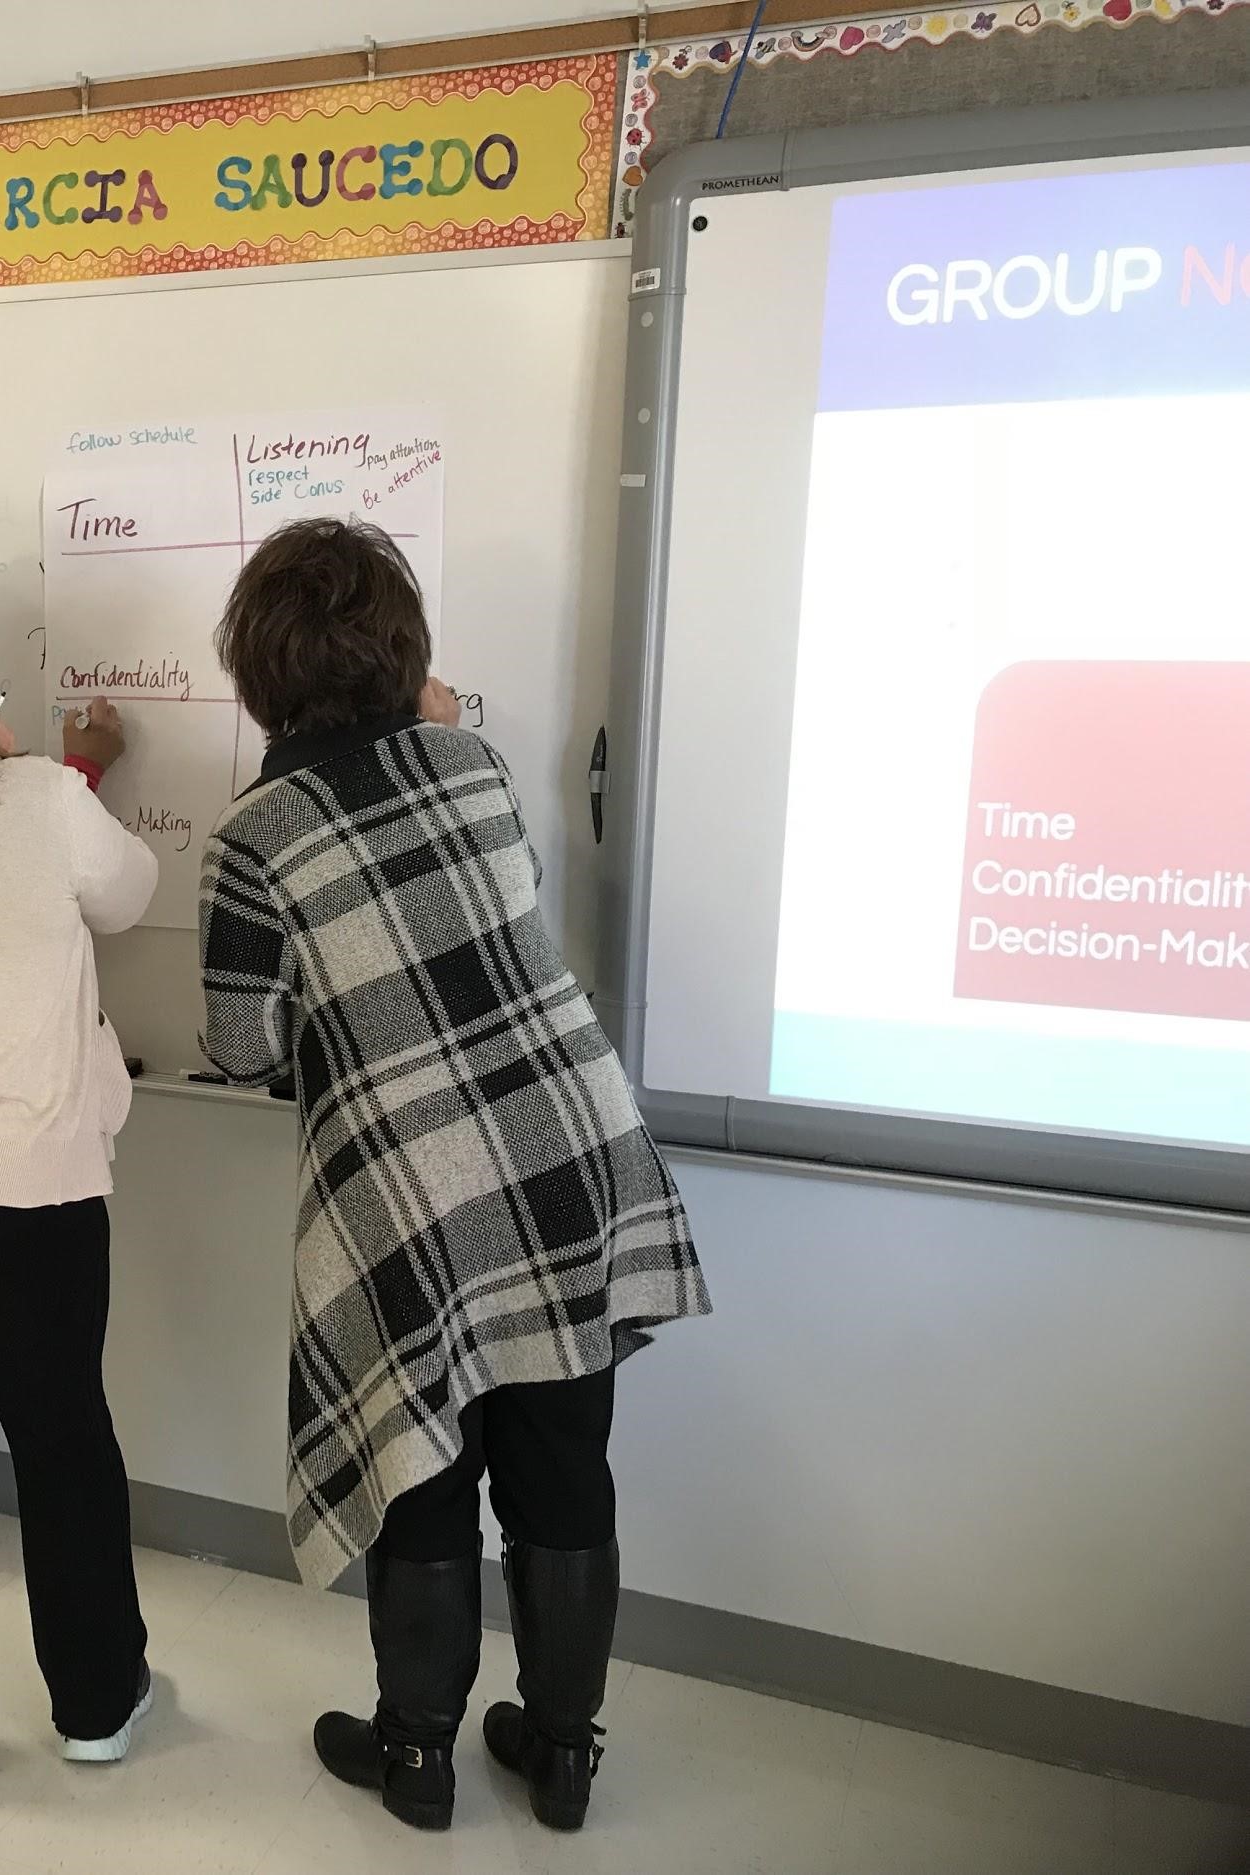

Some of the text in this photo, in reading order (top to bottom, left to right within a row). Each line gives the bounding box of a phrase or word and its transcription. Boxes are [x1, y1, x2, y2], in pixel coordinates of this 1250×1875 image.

[214, 133, 519, 211] SAUCEDO
[701, 175, 779, 191] PROMETHEAN
[886, 246, 1162, 326] GROUP
[66, 426, 198, 453] follow schedule
[247, 433, 370, 468] Listening
[367, 438, 441, 471] pay attention
[249, 465, 309, 486] respect
[388, 450, 441, 493] attentive
[57, 498, 138, 541] Time
[60, 659, 195, 702] Confidentiality
[978, 802, 1076, 841] Time
[972, 859, 1250, 909] Confidentialit
